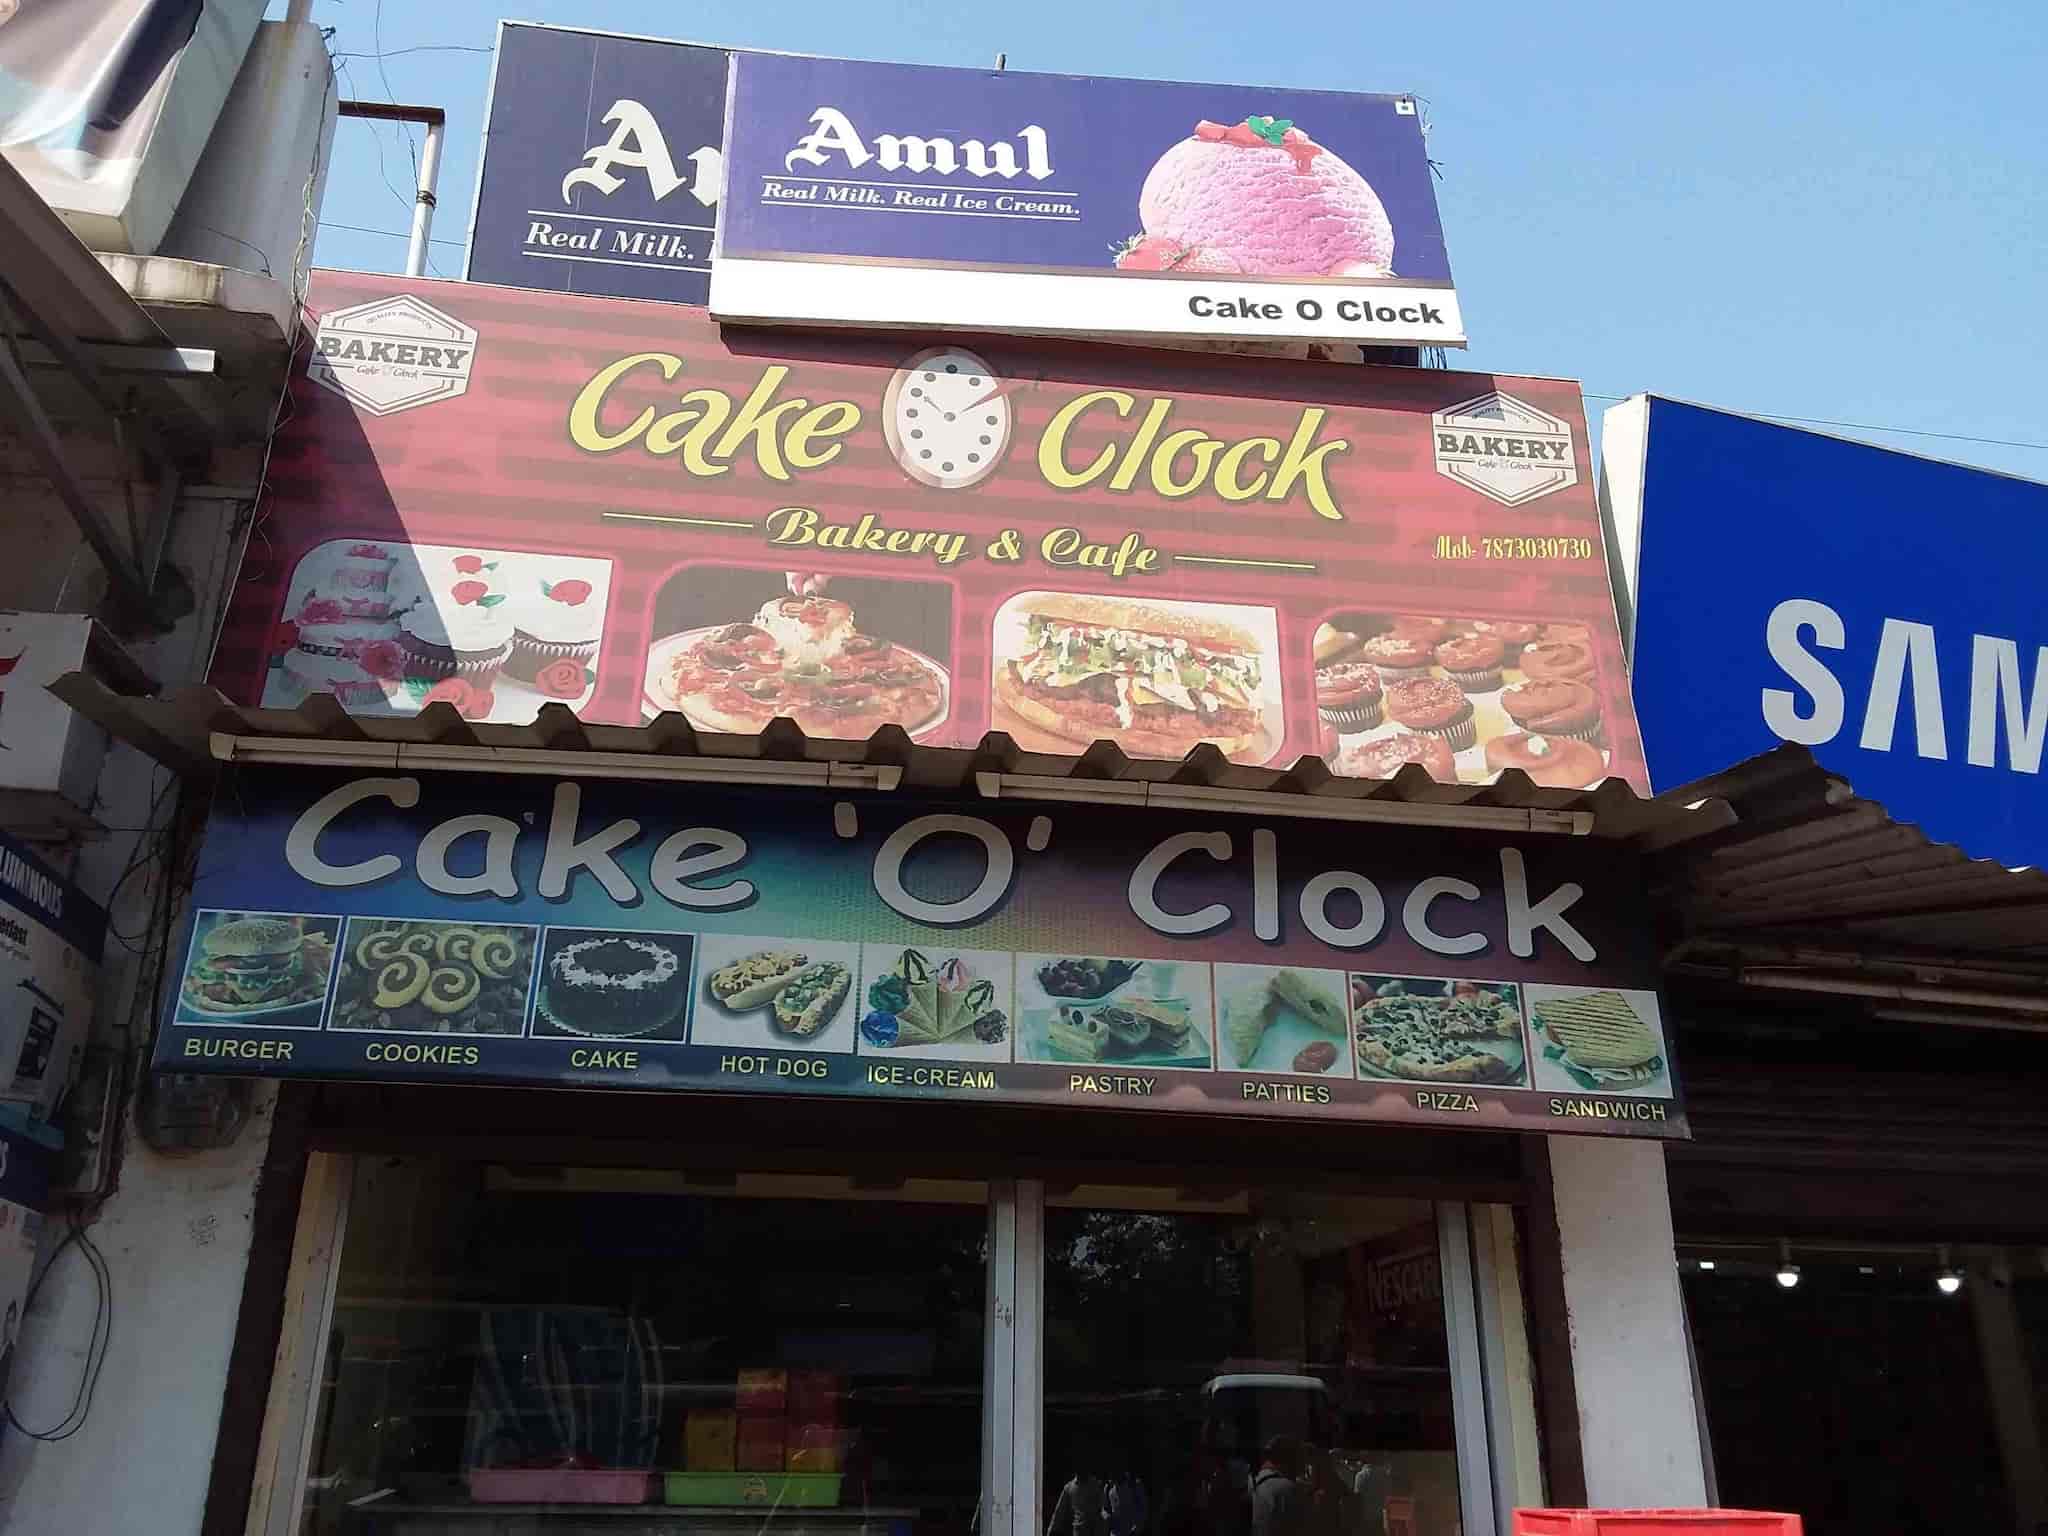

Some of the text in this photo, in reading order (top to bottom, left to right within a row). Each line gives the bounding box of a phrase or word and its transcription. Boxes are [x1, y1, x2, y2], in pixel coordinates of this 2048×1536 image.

[785, 107, 1055, 181] Amul
[761, 183, 1080, 215] Real Milk. Real Ice Cream.
[524, 222, 603, 250] Real
[609, 230, 694, 260] Milk.
[1188, 295, 1445, 324] Cake O Clock
[318, 336, 469, 370] BAKERY
[570, 352, 1348, 520] Cake Clock
[1437, 433, 1569, 461] BAKERY
[766, 507, 1160, 577] Bakery & Cafe
[1481, 536, 1592, 560] 7873030730
[286, 777, 754, 907] Cake
[1128, 828, 1597, 962] Clock
[183, 1038, 294, 1060] BURGER
[365, 1042, 481, 1065] COOKIES
[570, 1049, 638, 1070] CAKE
[720, 1055, 828, 1078] HOT DOG
[867, 1064, 995, 1089] ICE-CREAM
[1069, 1074, 1156, 1095] PASTRY
[1241, 1082, 1330, 1104] PATTIES
[1416, 1092, 1480, 1113] PIZZA
[1549, 1098, 1667, 1121] SANDWICH
